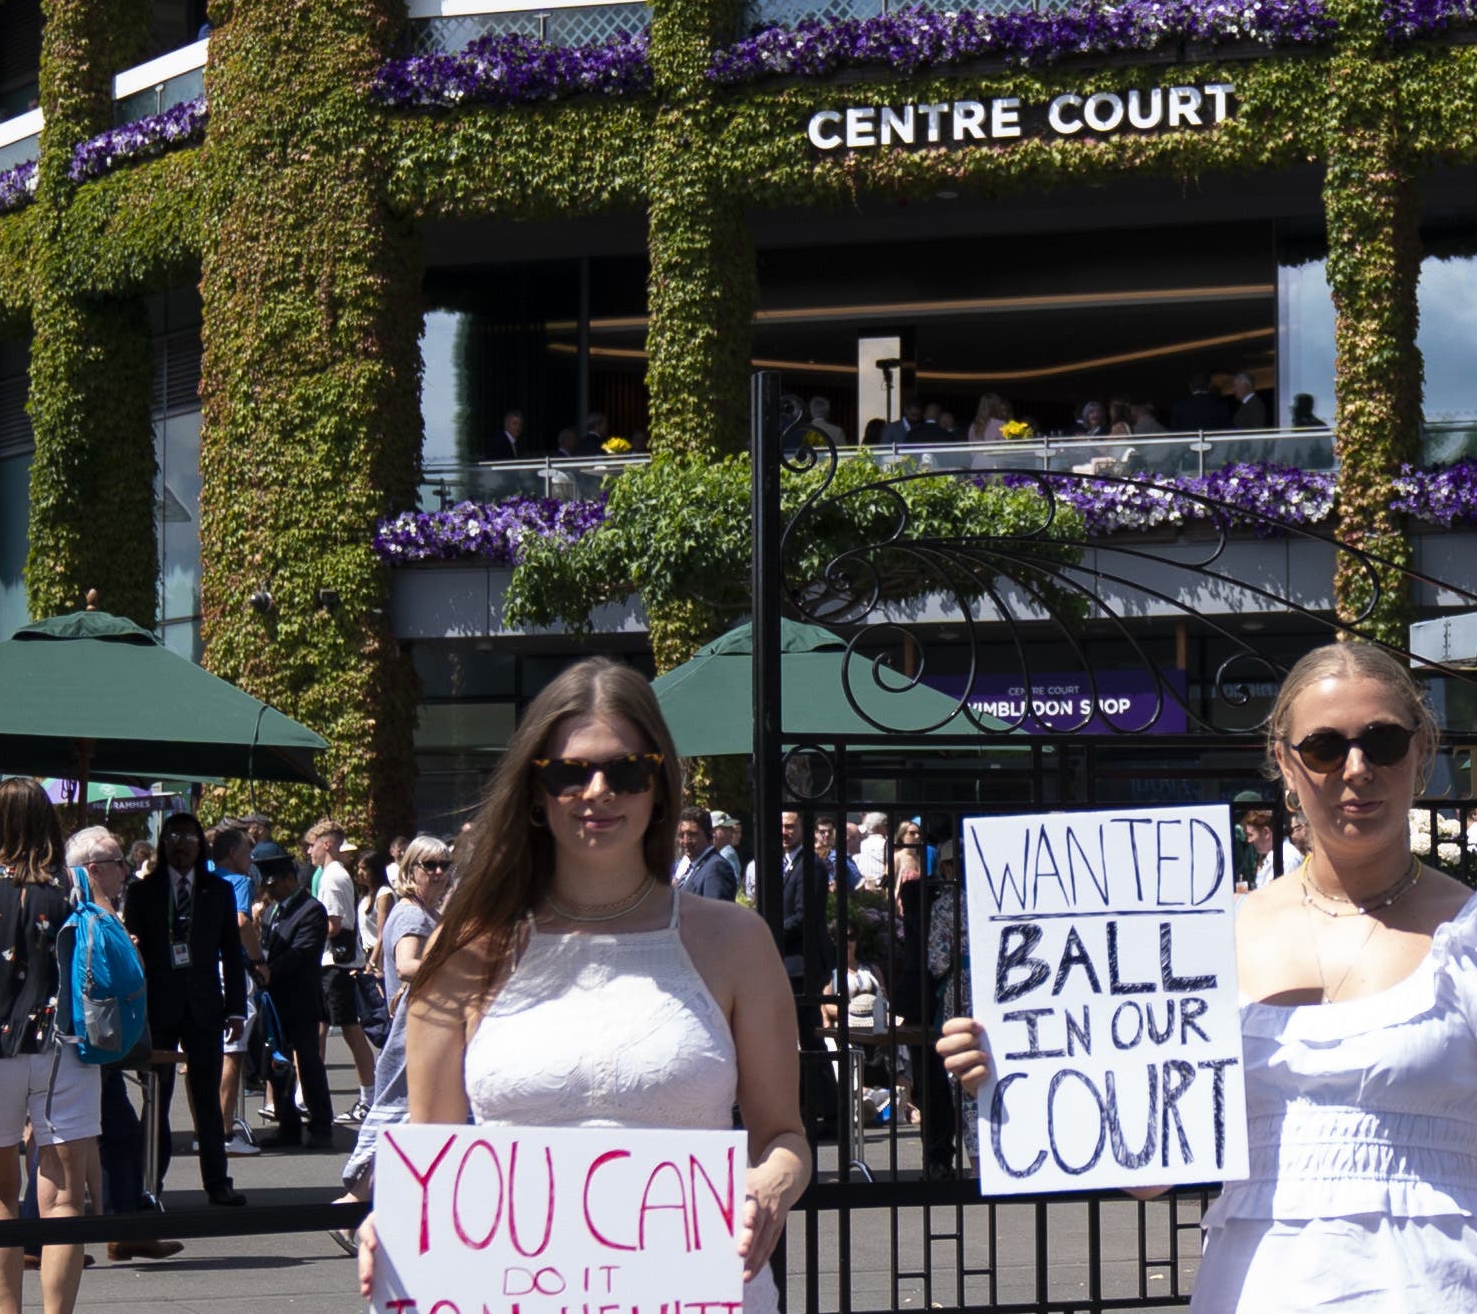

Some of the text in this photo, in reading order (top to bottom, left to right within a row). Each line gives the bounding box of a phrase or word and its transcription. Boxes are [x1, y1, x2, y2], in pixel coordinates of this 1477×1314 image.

[807, 84, 1235, 150] CENTRE COURT
[1048, 685, 1080, 695] COURT
[970, 817, 1224, 912] WANTED
[993, 920, 1219, 1005] BALL
[1003, 996, 1212, 1061] IN OUR
[989, 1057, 1239, 1179] COURT
[383, 1130, 736, 1258] YOU CAN
[502, 1264, 621, 1295] DO IT
